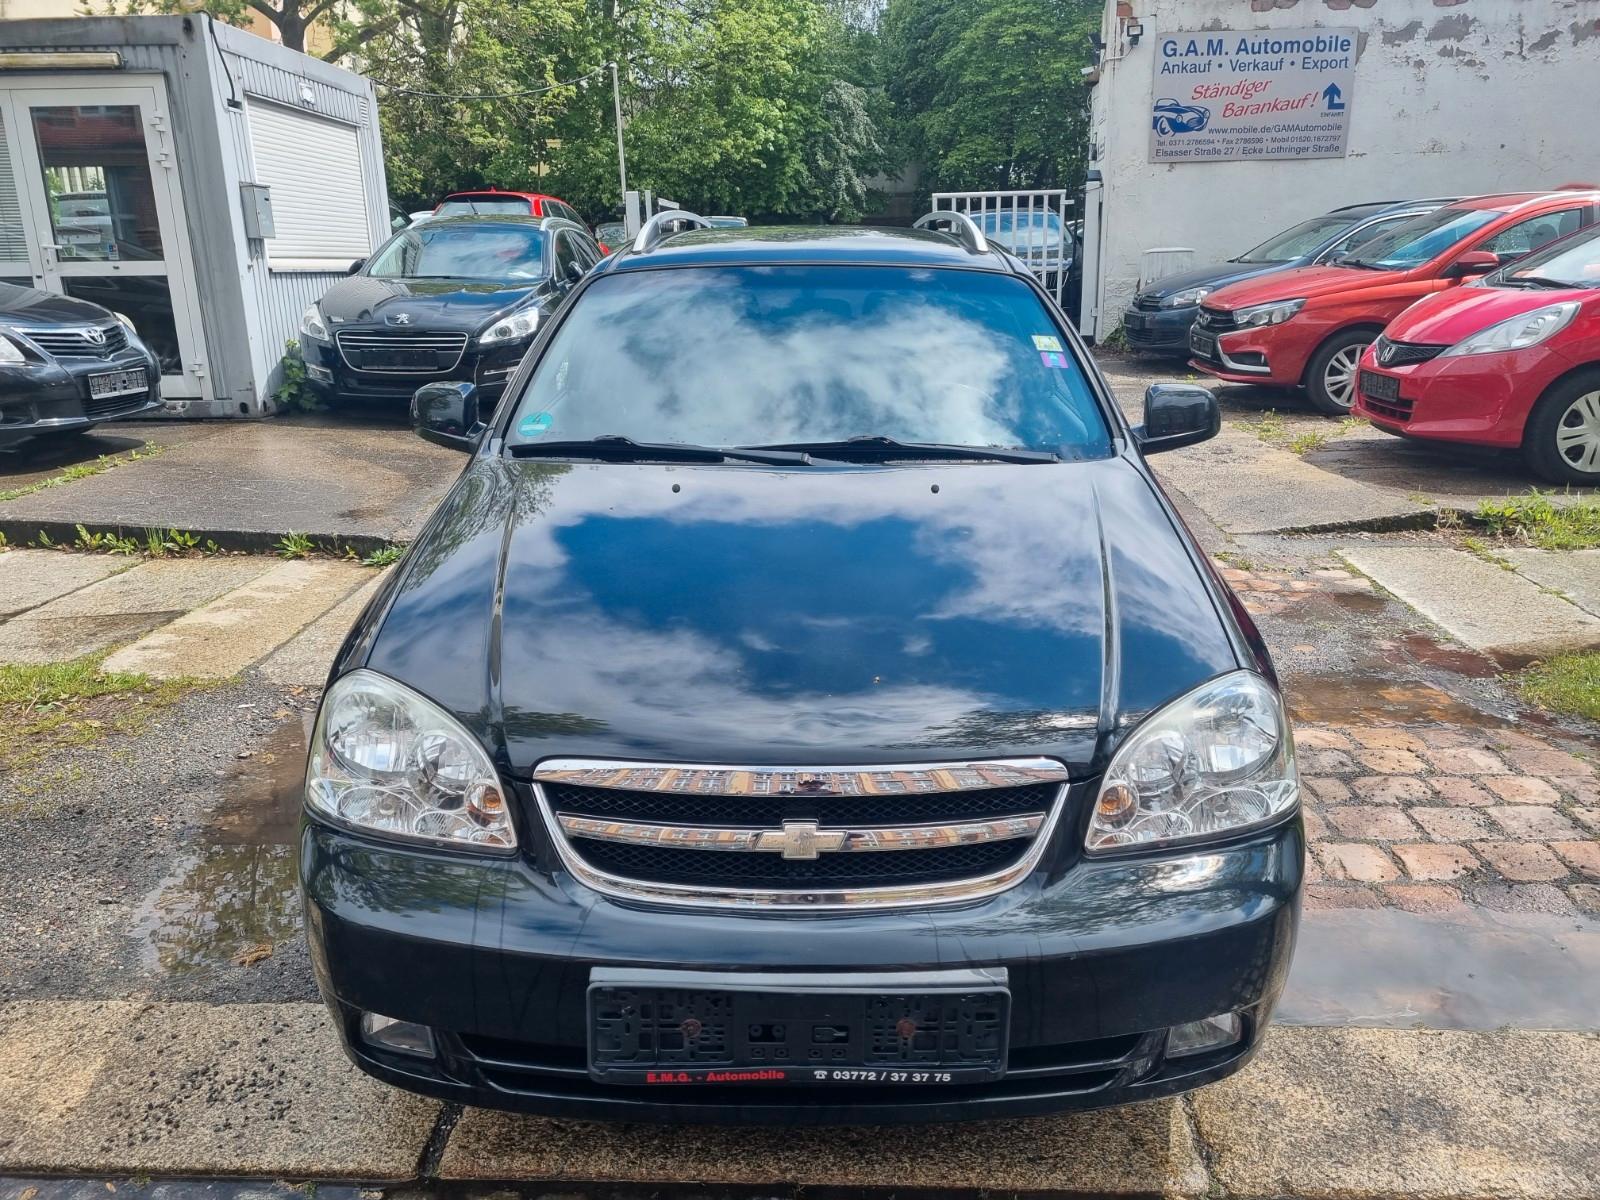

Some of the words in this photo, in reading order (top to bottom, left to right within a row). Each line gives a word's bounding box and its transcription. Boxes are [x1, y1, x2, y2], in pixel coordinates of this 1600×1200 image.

[1162, 38, 1229, 58] G.A.M.
[1235, 35, 1352, 56] Automobile
[1161, 59, 1213, 74] Ankauf
[1229, 57, 1284, 73] Verkauf
[1301, 56, 1349, 72] Export
[1191, 78, 1273, 100] Ständiger
[1222, 91, 1319, 118] Barankauf!
[1207, 122, 1343, 135] www.mobile.de/GAMAutomobile
[1221, 137, 1234, 145] Fax
[1270, 135, 1290, 144] Mobil
[1155, 147, 1193, 157] Elsasser
[1193, 146, 1222, 156] Straße
[1223, 145, 1235, 155] 27
[1241, 145, 1264, 155] Ecke
[1265, 143, 1309, 155] Lothringer
[1311, 143, 1340, 153] Straße
[706, 1070, 785, 1082] Automobile
[832, 1070, 877, 1081] 03772
[890, 1072, 908, 1081] 37
[911, 1073, 930, 1082] 37
[934, 1073, 951, 1082] 75
